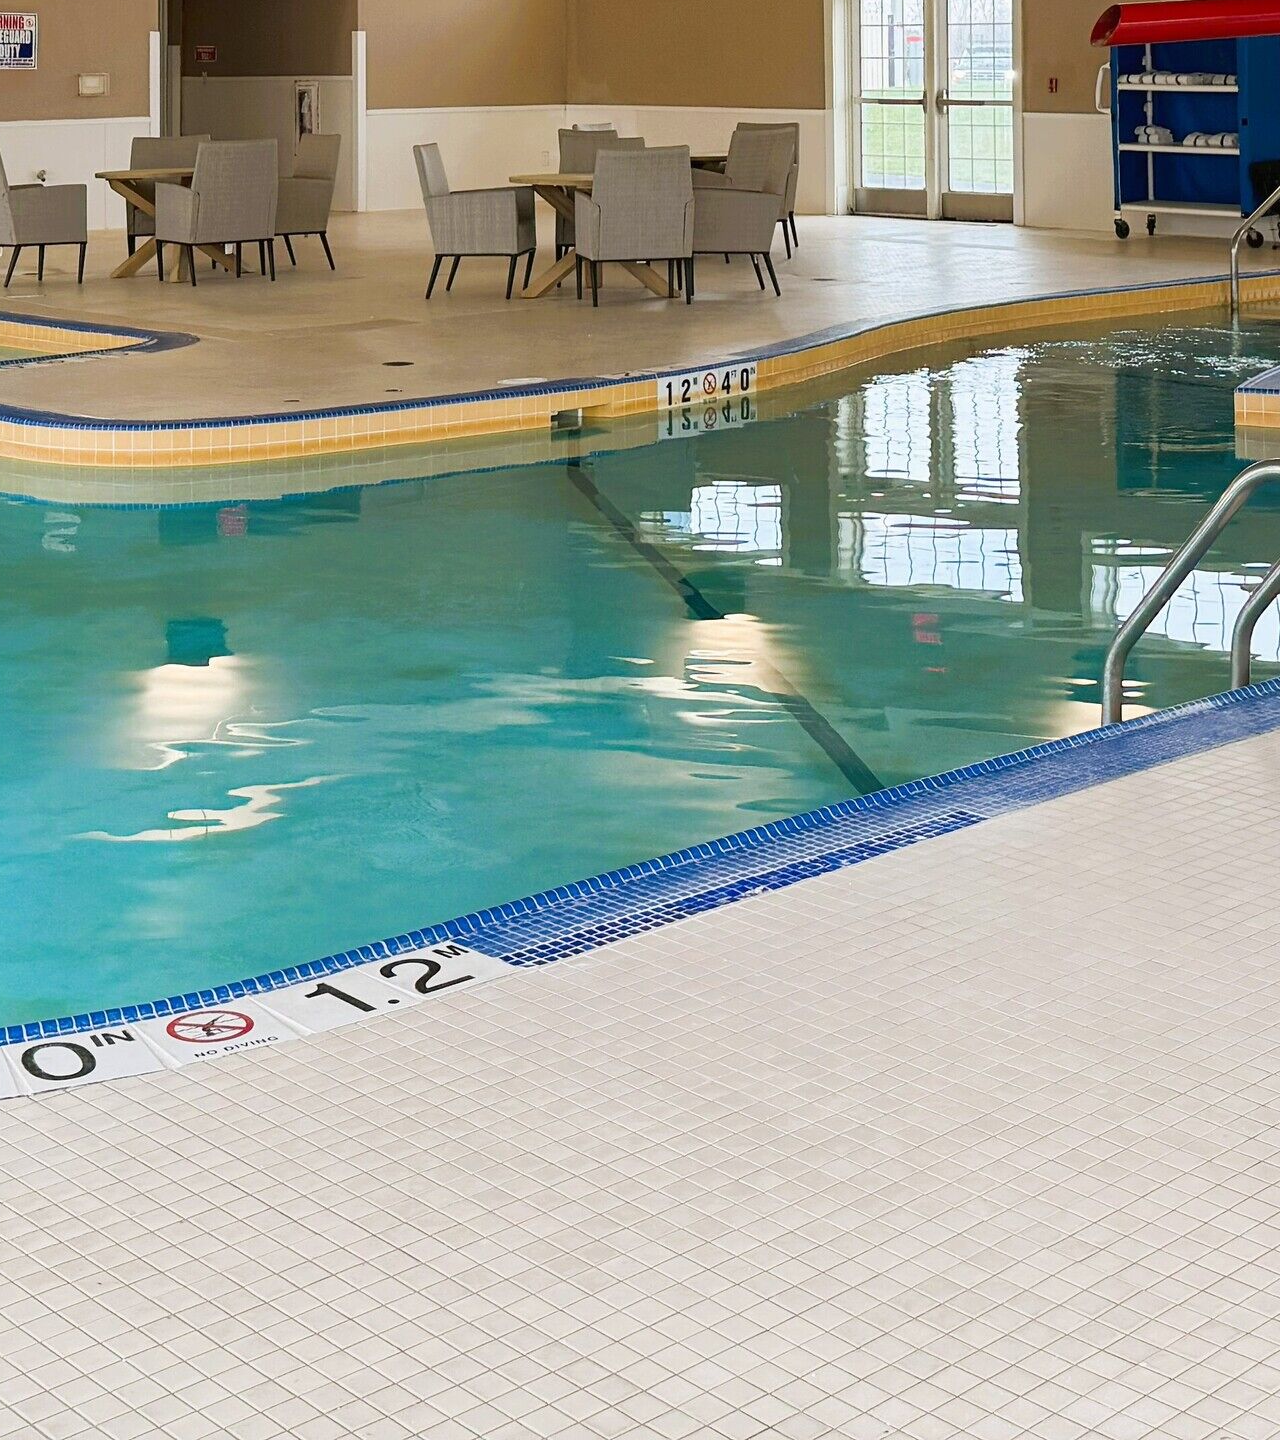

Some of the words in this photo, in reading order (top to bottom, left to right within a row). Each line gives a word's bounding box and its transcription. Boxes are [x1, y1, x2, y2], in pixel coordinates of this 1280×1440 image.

[305, 958, 474, 1013] 1.2
[434, 944, 470, 959] M
[194, 1049, 218, 1058] NO
[223, 1036, 278, 1051] DIVING
